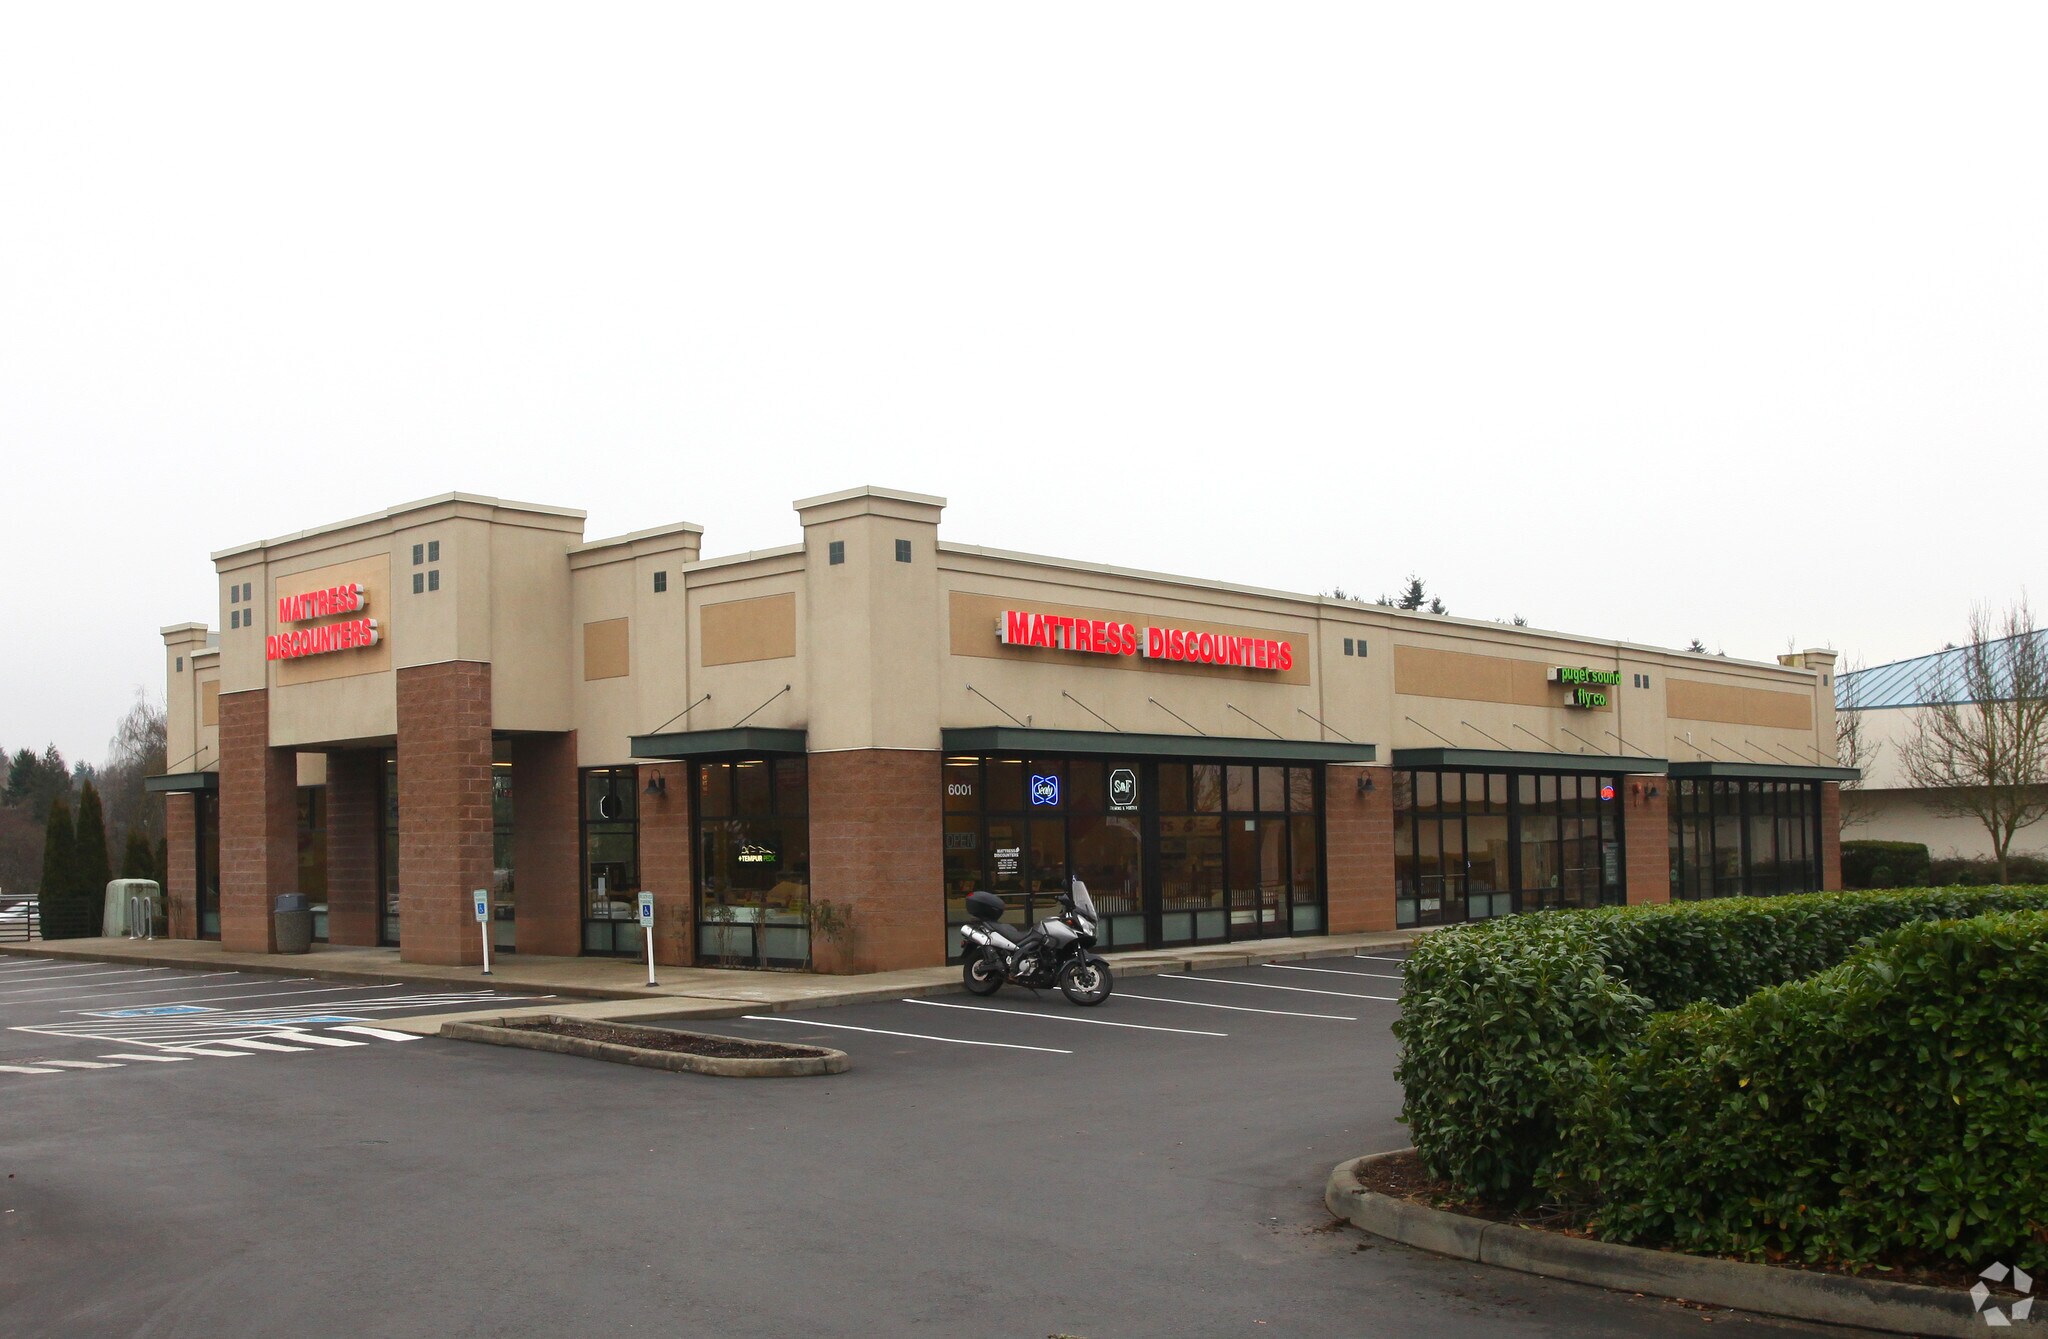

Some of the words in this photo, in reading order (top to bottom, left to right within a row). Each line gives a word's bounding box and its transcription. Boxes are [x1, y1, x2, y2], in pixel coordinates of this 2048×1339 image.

[279, 583, 358, 623] MATTRESS
[266, 618, 372, 661] DISCOUNTERS
[1007, 610, 1138, 656] MATTRESS
[1148, 627, 1294, 671] DISCOUNTERS
[1561, 667, 1590, 684] puget
[1591, 670, 1622, 685] sound
[1577, 688, 1591, 708] fly
[1593, 693, 1608, 706] co.
[948, 783, 972, 796] 6001
[1036, 783, 1054, 797] Sealy
[945, 834, 977, 849] OPEN
